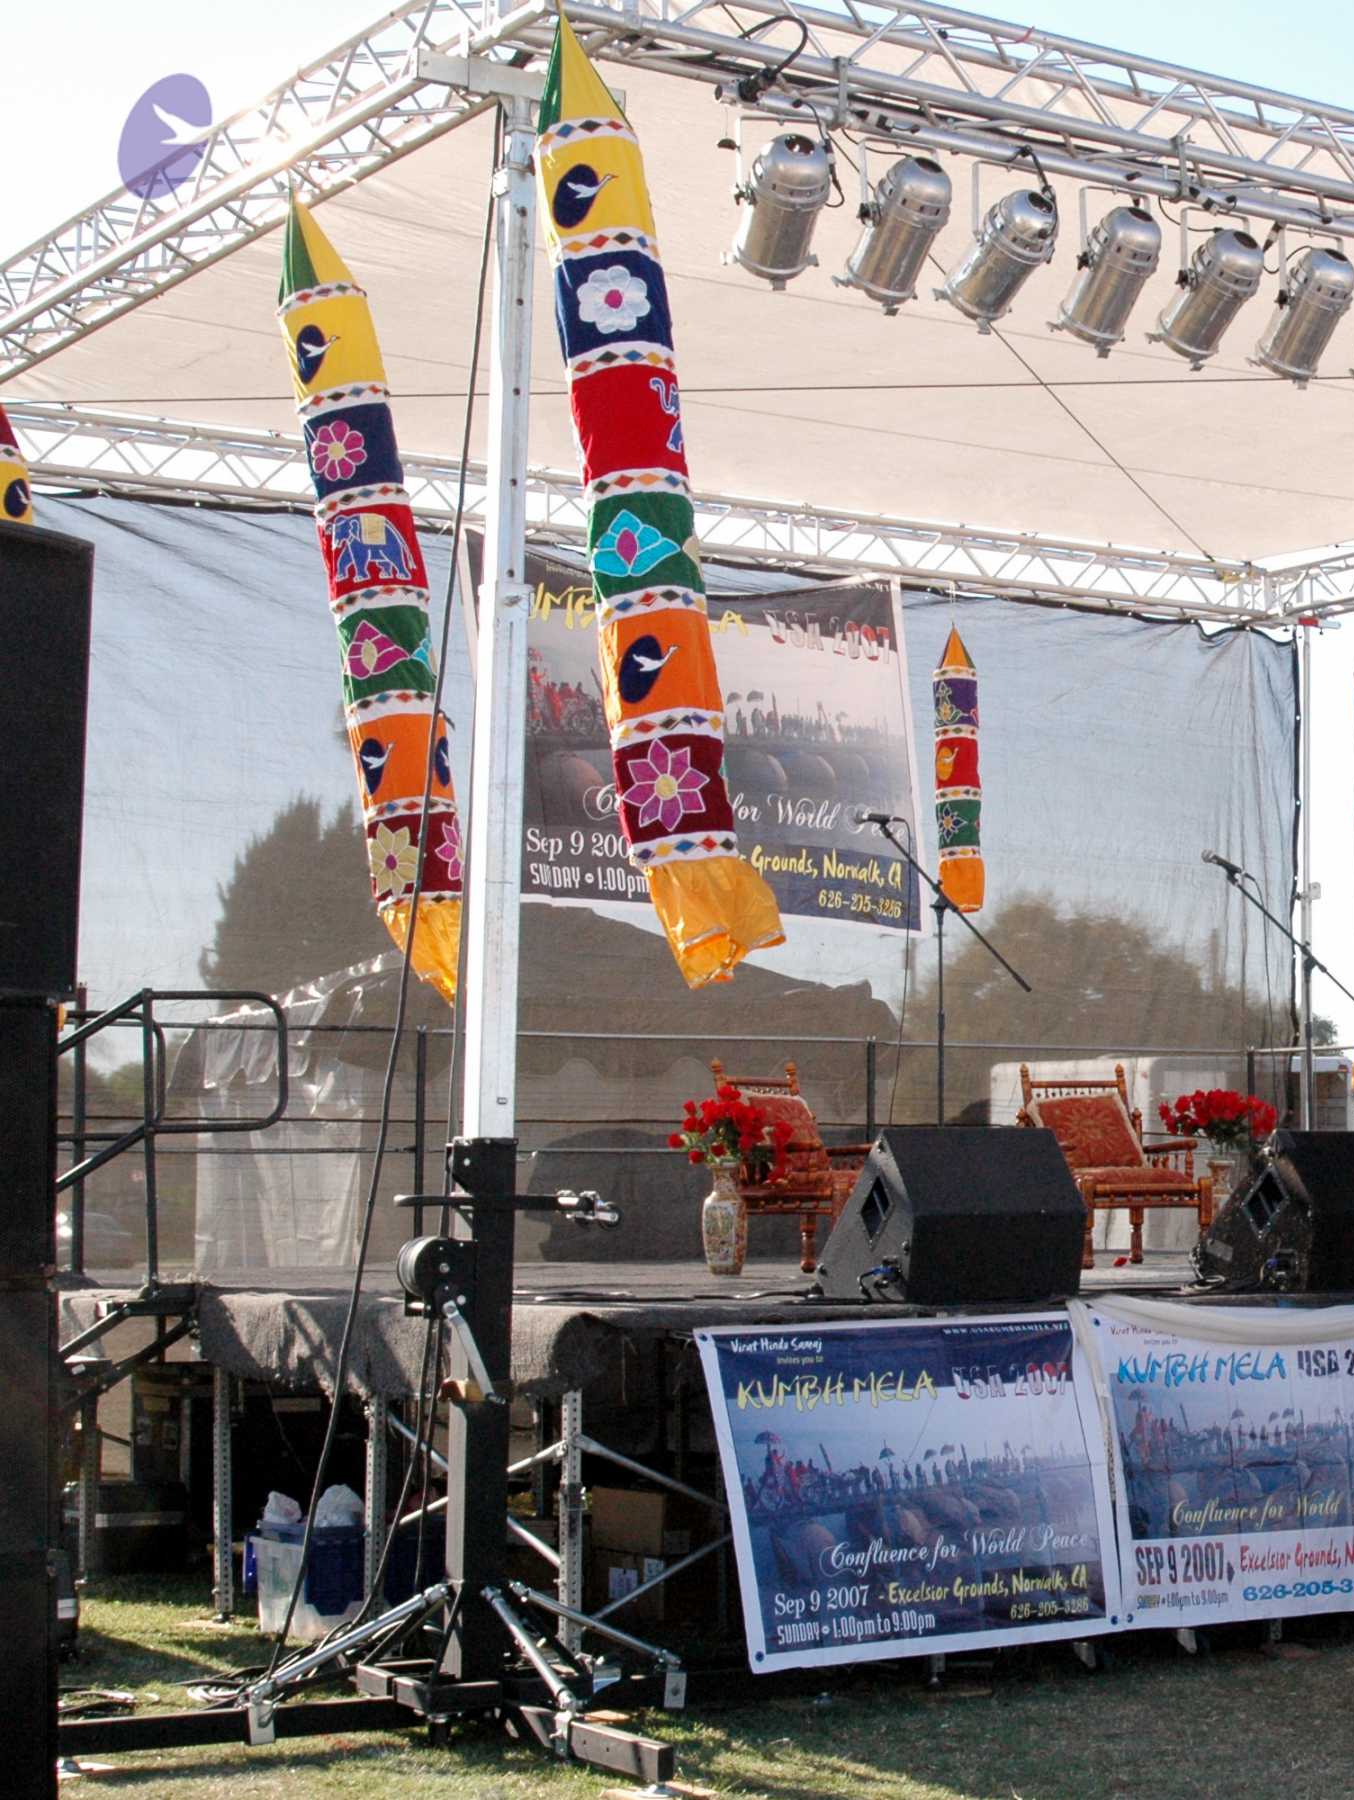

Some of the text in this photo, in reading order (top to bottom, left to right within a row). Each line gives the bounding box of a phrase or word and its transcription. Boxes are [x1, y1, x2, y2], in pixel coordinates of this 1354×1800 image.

[763, 609, 823, 651] USA
[828, 615, 890, 664] 2007
[767, 793, 841, 830] World
[844, 803, 905, 841] Pee
[526, 827, 630, 861] Sep 9 200
[751, 844, 902, 891] Grounds, Norwalk, CA
[731, 1338, 758, 1353] Virat
[1117, 1351, 1209, 1387] KUMBH
[1215, 1350, 1287, 1386] MELA
[737, 1361, 1068, 1412] KUMBH MELA USA 2007
[1173, 1497, 1257, 1532] Confluence
[1255, 1496, 1285, 1529] for
[1295, 1490, 1344, 1517] World
[819, 1523, 1088, 1577] Confluence for World Peace
[1135, 1546, 1164, 1586] SEP
[1167, 1545, 1178, 1584] 9
[1181, 1542, 1225, 1583] 2007
[1240, 1545, 1290, 1573] Excelsior
[1294, 1538, 1341, 1577] Grounds,
[774, 1593, 805, 1619] Sep
[809, 1589, 821, 1613] 9
[827, 1585, 869, 1610] 2007
[888, 1581, 949, 1605] Excelsior
[953, 1573, 1009, 1607] Grounds,
[1012, 1567, 1067, 1595] Norwalk,
[1070, 1564, 1088, 1589] CA
[1191, 1592, 1200, 1606] to
[777, 1609, 936, 1645] SUNDAY 1:00pm to 9:00pm
